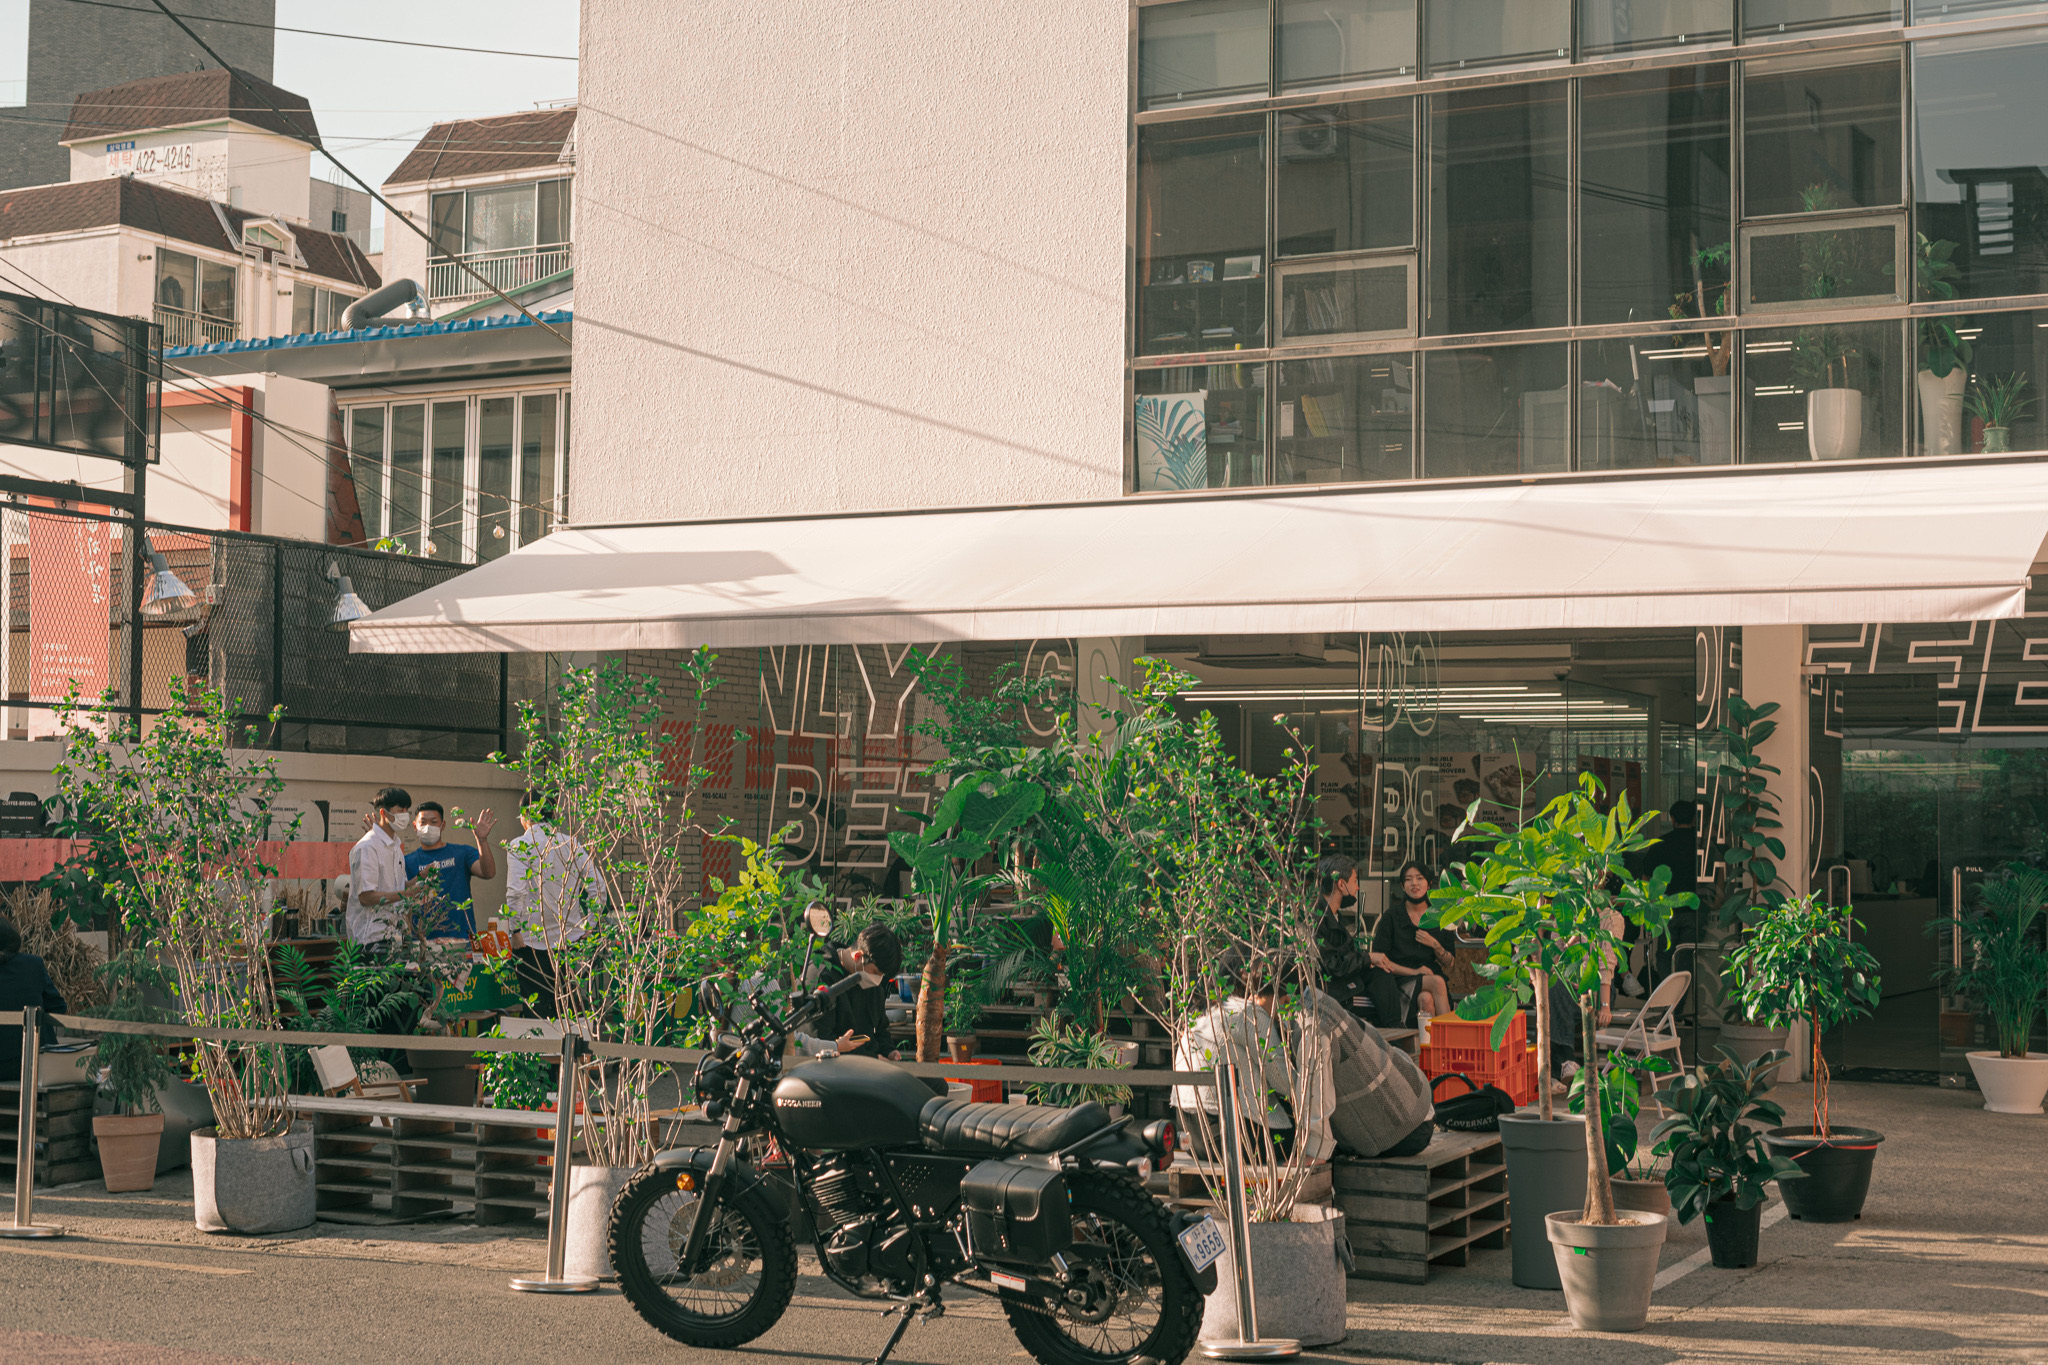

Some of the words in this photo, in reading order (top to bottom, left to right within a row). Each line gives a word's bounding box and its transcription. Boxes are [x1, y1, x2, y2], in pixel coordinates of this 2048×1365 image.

[108, 150, 133, 168] 세탁
[136, 145, 191, 174] 422-4246
[448, 989, 474, 1003] mass
[1196, 1230, 1222, 1259] 9656
